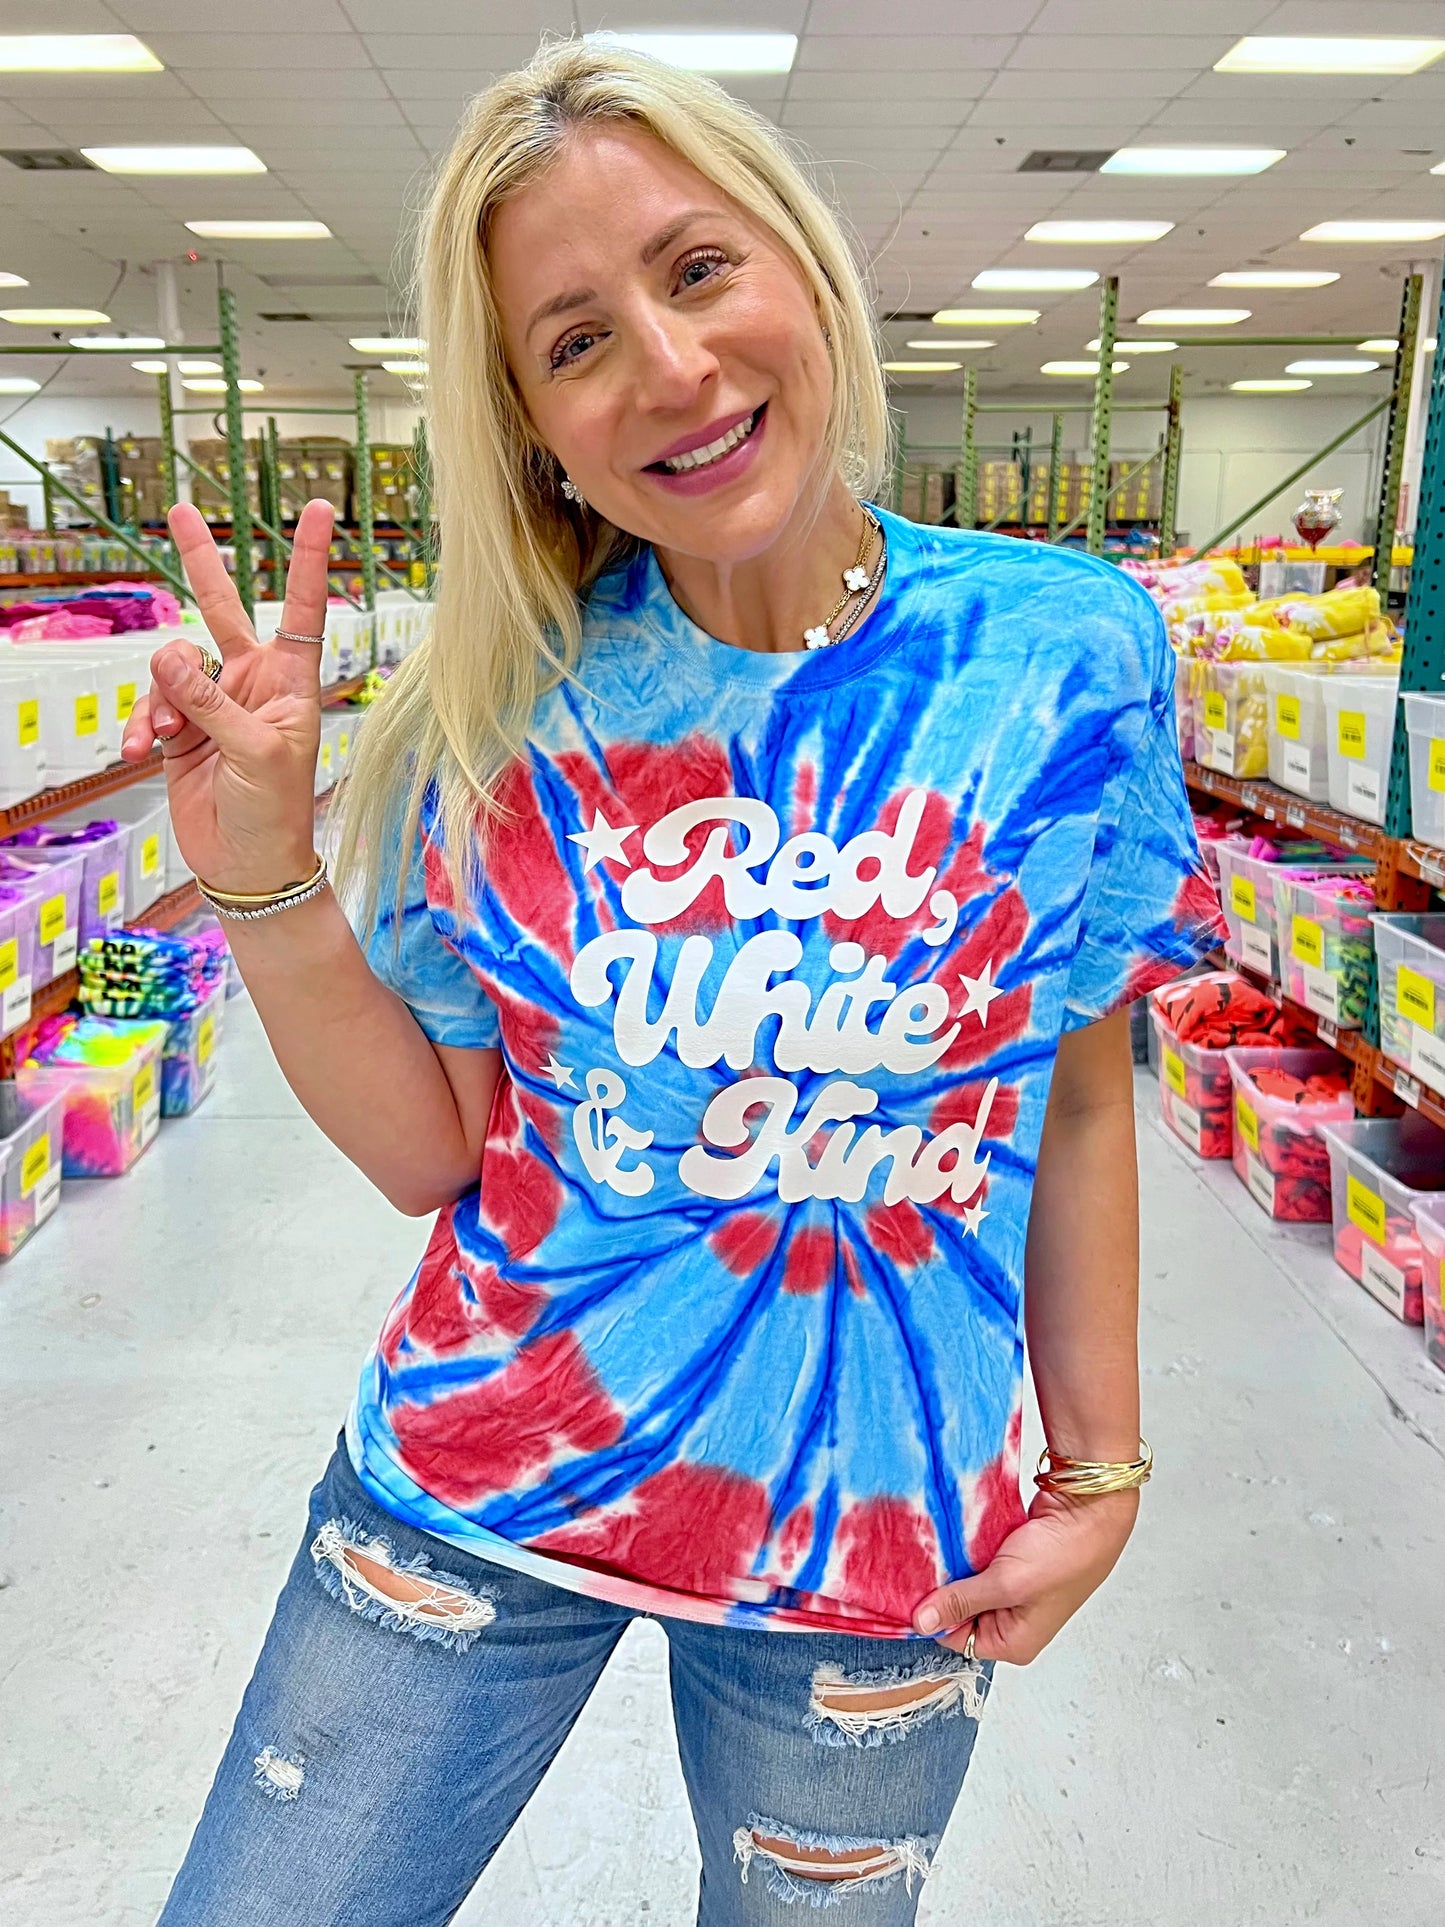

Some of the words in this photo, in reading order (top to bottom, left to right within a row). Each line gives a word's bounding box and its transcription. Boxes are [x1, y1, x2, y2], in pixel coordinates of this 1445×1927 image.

[621, 789, 958, 946] Red,
[570, 929, 961, 1074] White
[573, 1068, 654, 1197] &
[678, 1076, 998, 1206] Kind
